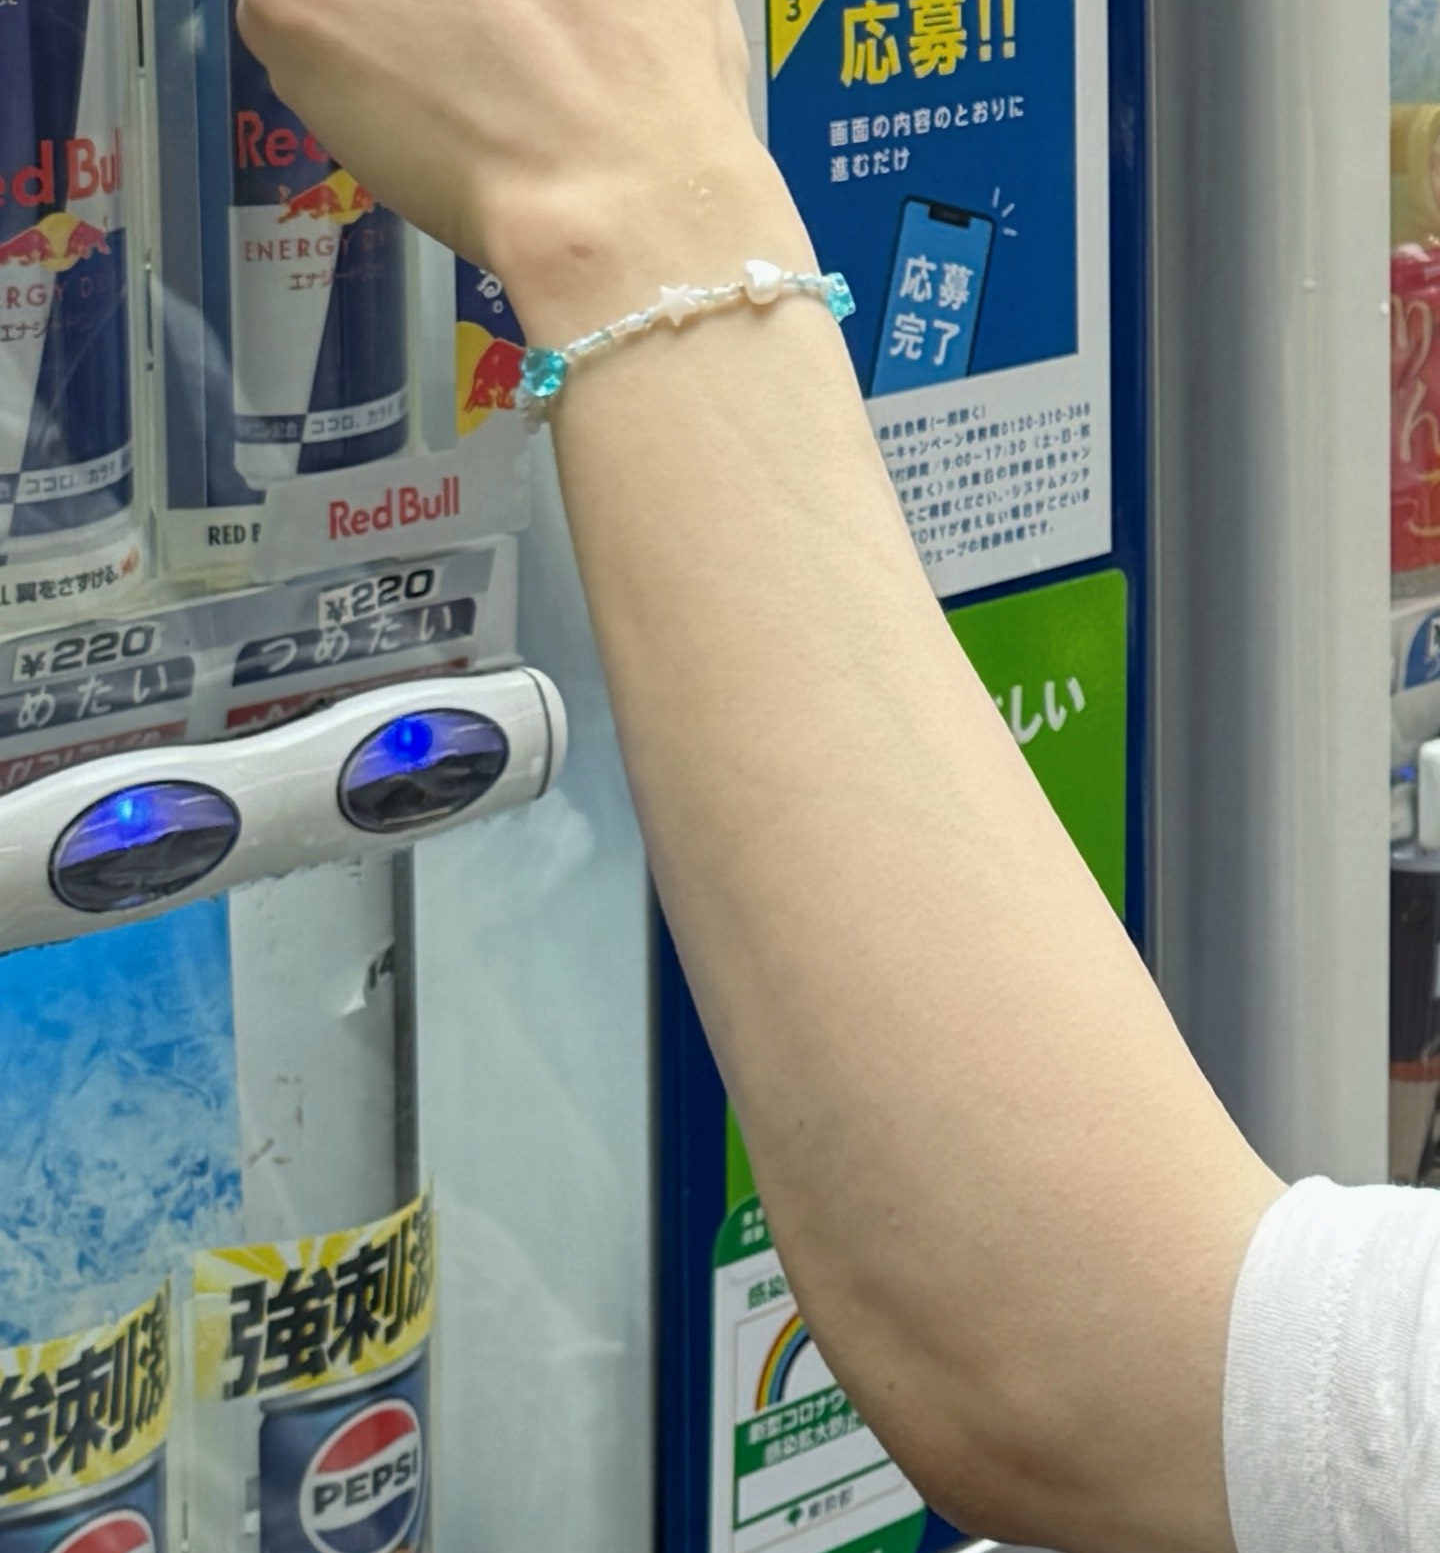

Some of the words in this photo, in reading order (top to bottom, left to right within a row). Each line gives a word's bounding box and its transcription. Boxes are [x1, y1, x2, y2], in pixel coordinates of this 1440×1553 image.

[829, 93, 1025, 147] 画面の内容のとおりに
[829, 149, 911, 184] 進むだけ
[243, 232, 352, 264] ENERGY
[898, 253, 976, 312] 応募
[888, 313, 963, 368] 完了
[328, 489, 393, 541] Red
[398, 475, 461, 526] Bull
[208, 524, 244, 547] RED
[324, 568, 436, 622] ¥220
[20, 625, 156, 679] ¥220
[260, 604, 453, 673] つめたい
[995, 675, 1087, 748] しい
[312, 1447, 419, 1518] PEPSI
